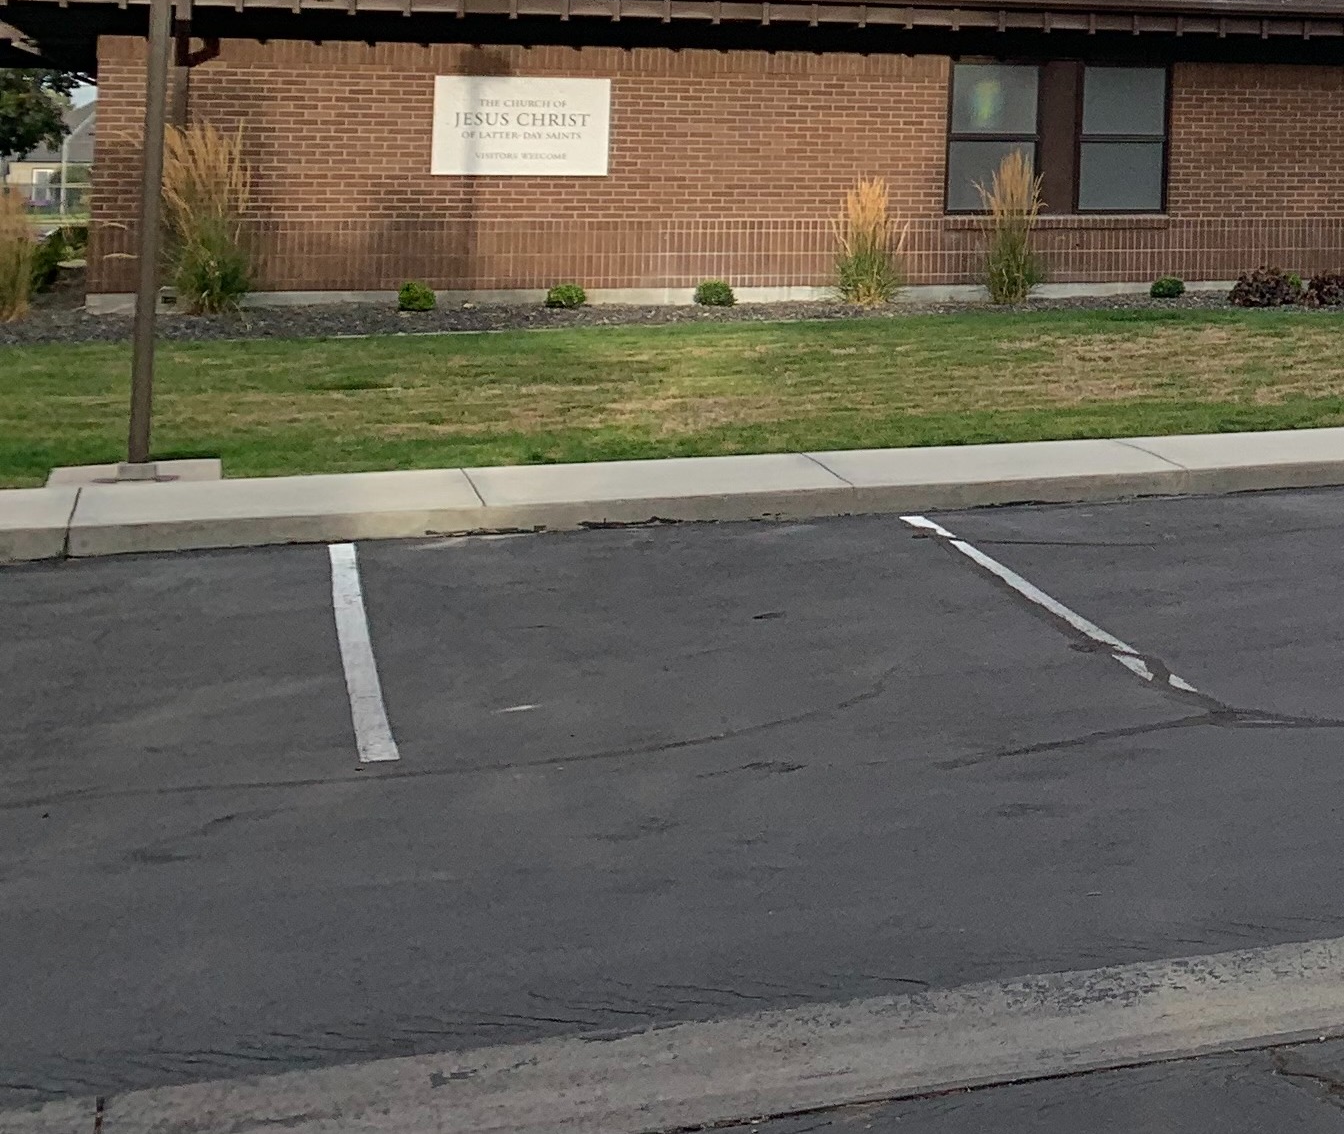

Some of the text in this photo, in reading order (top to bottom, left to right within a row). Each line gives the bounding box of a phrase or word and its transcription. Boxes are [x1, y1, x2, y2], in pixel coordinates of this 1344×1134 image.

[480, 99, 500, 107] THE
[455, 112, 590, 127] JESUS CHRIST
[461, 131, 476, 139] OF
